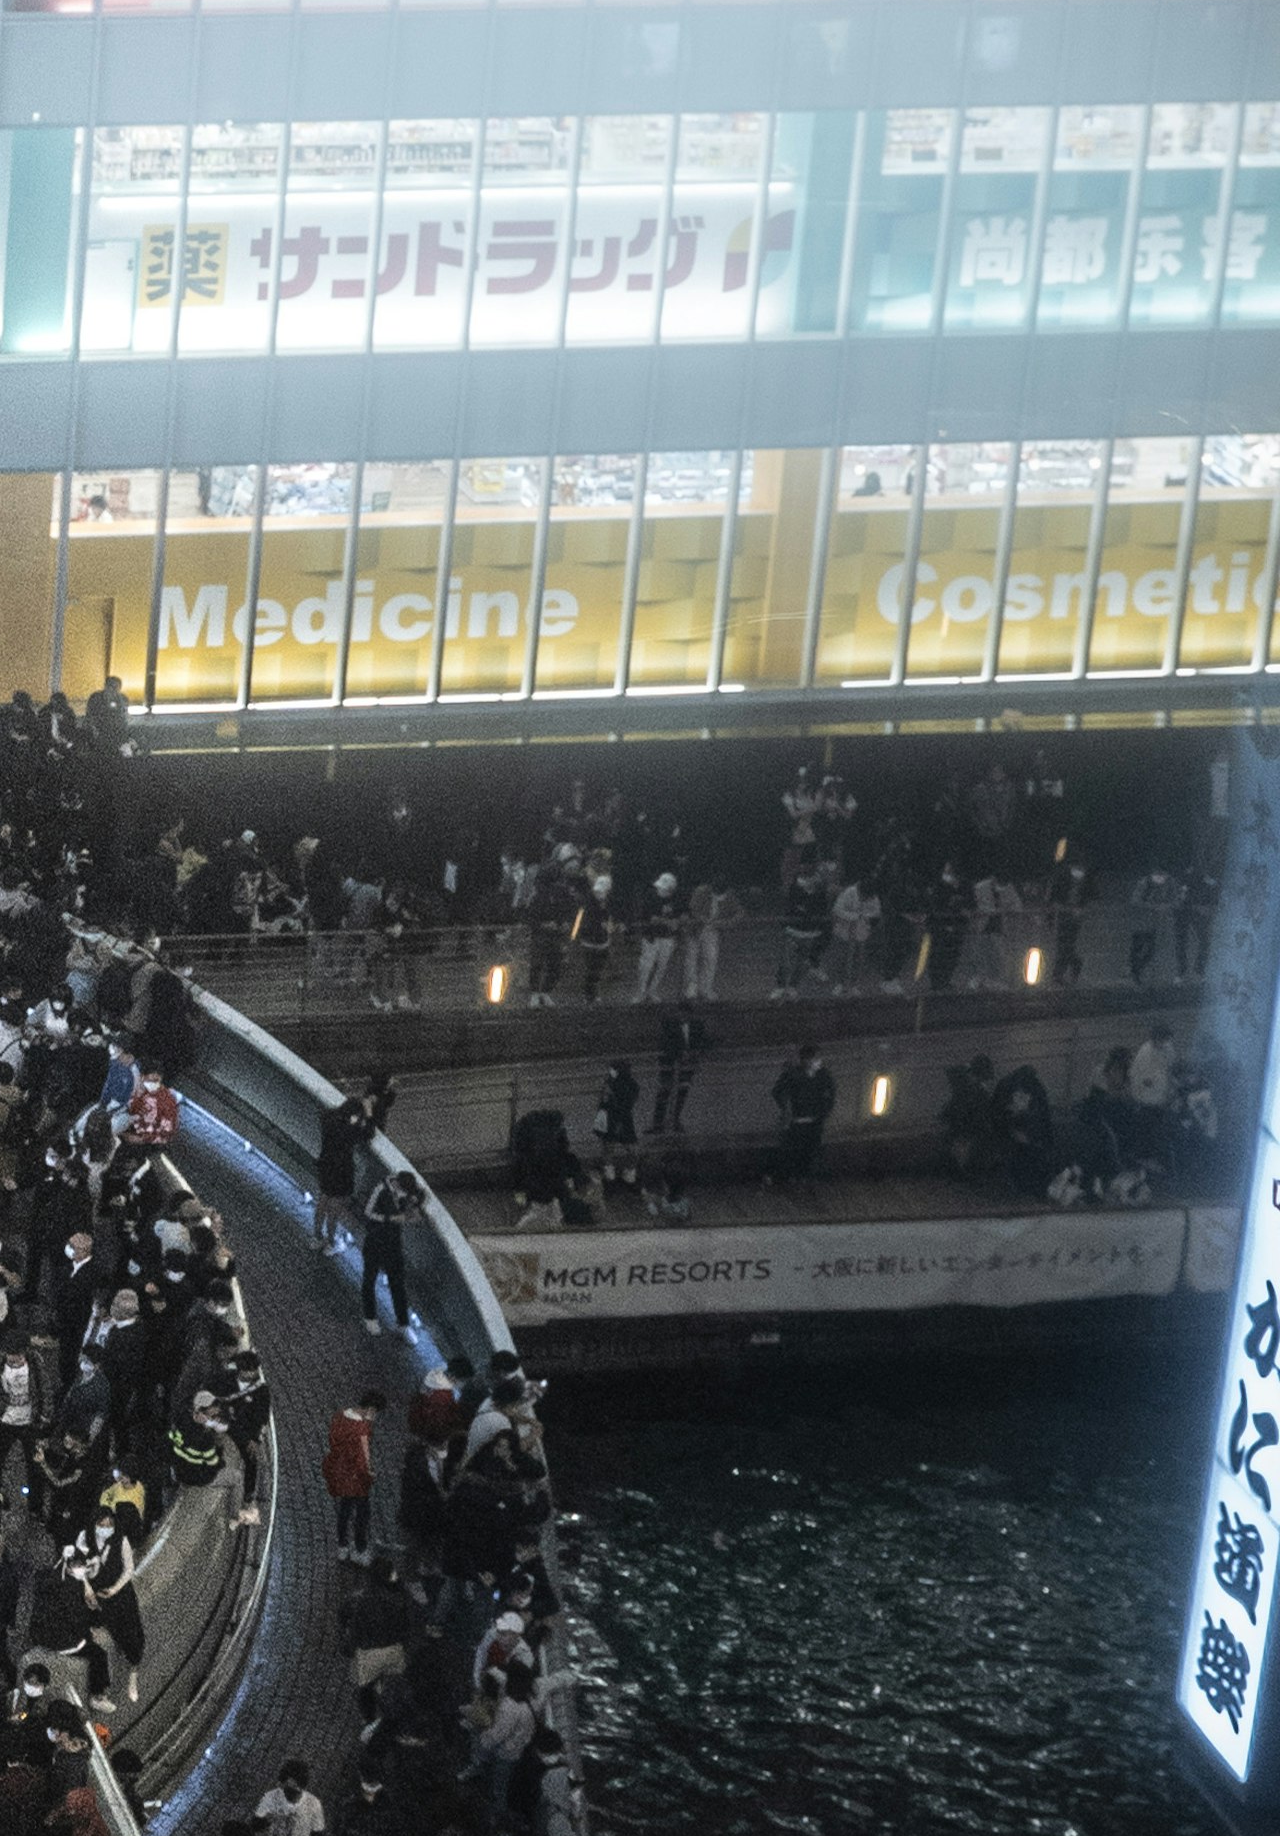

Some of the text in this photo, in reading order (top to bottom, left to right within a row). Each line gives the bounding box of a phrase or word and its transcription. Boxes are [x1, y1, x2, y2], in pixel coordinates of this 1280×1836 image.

[144, 230, 222, 304] 薬
[249, 218, 705, 302] サンドラッグ
[158, 577, 581, 650] Medicine
[542, 1258, 772, 1290] MGM RESORTS
